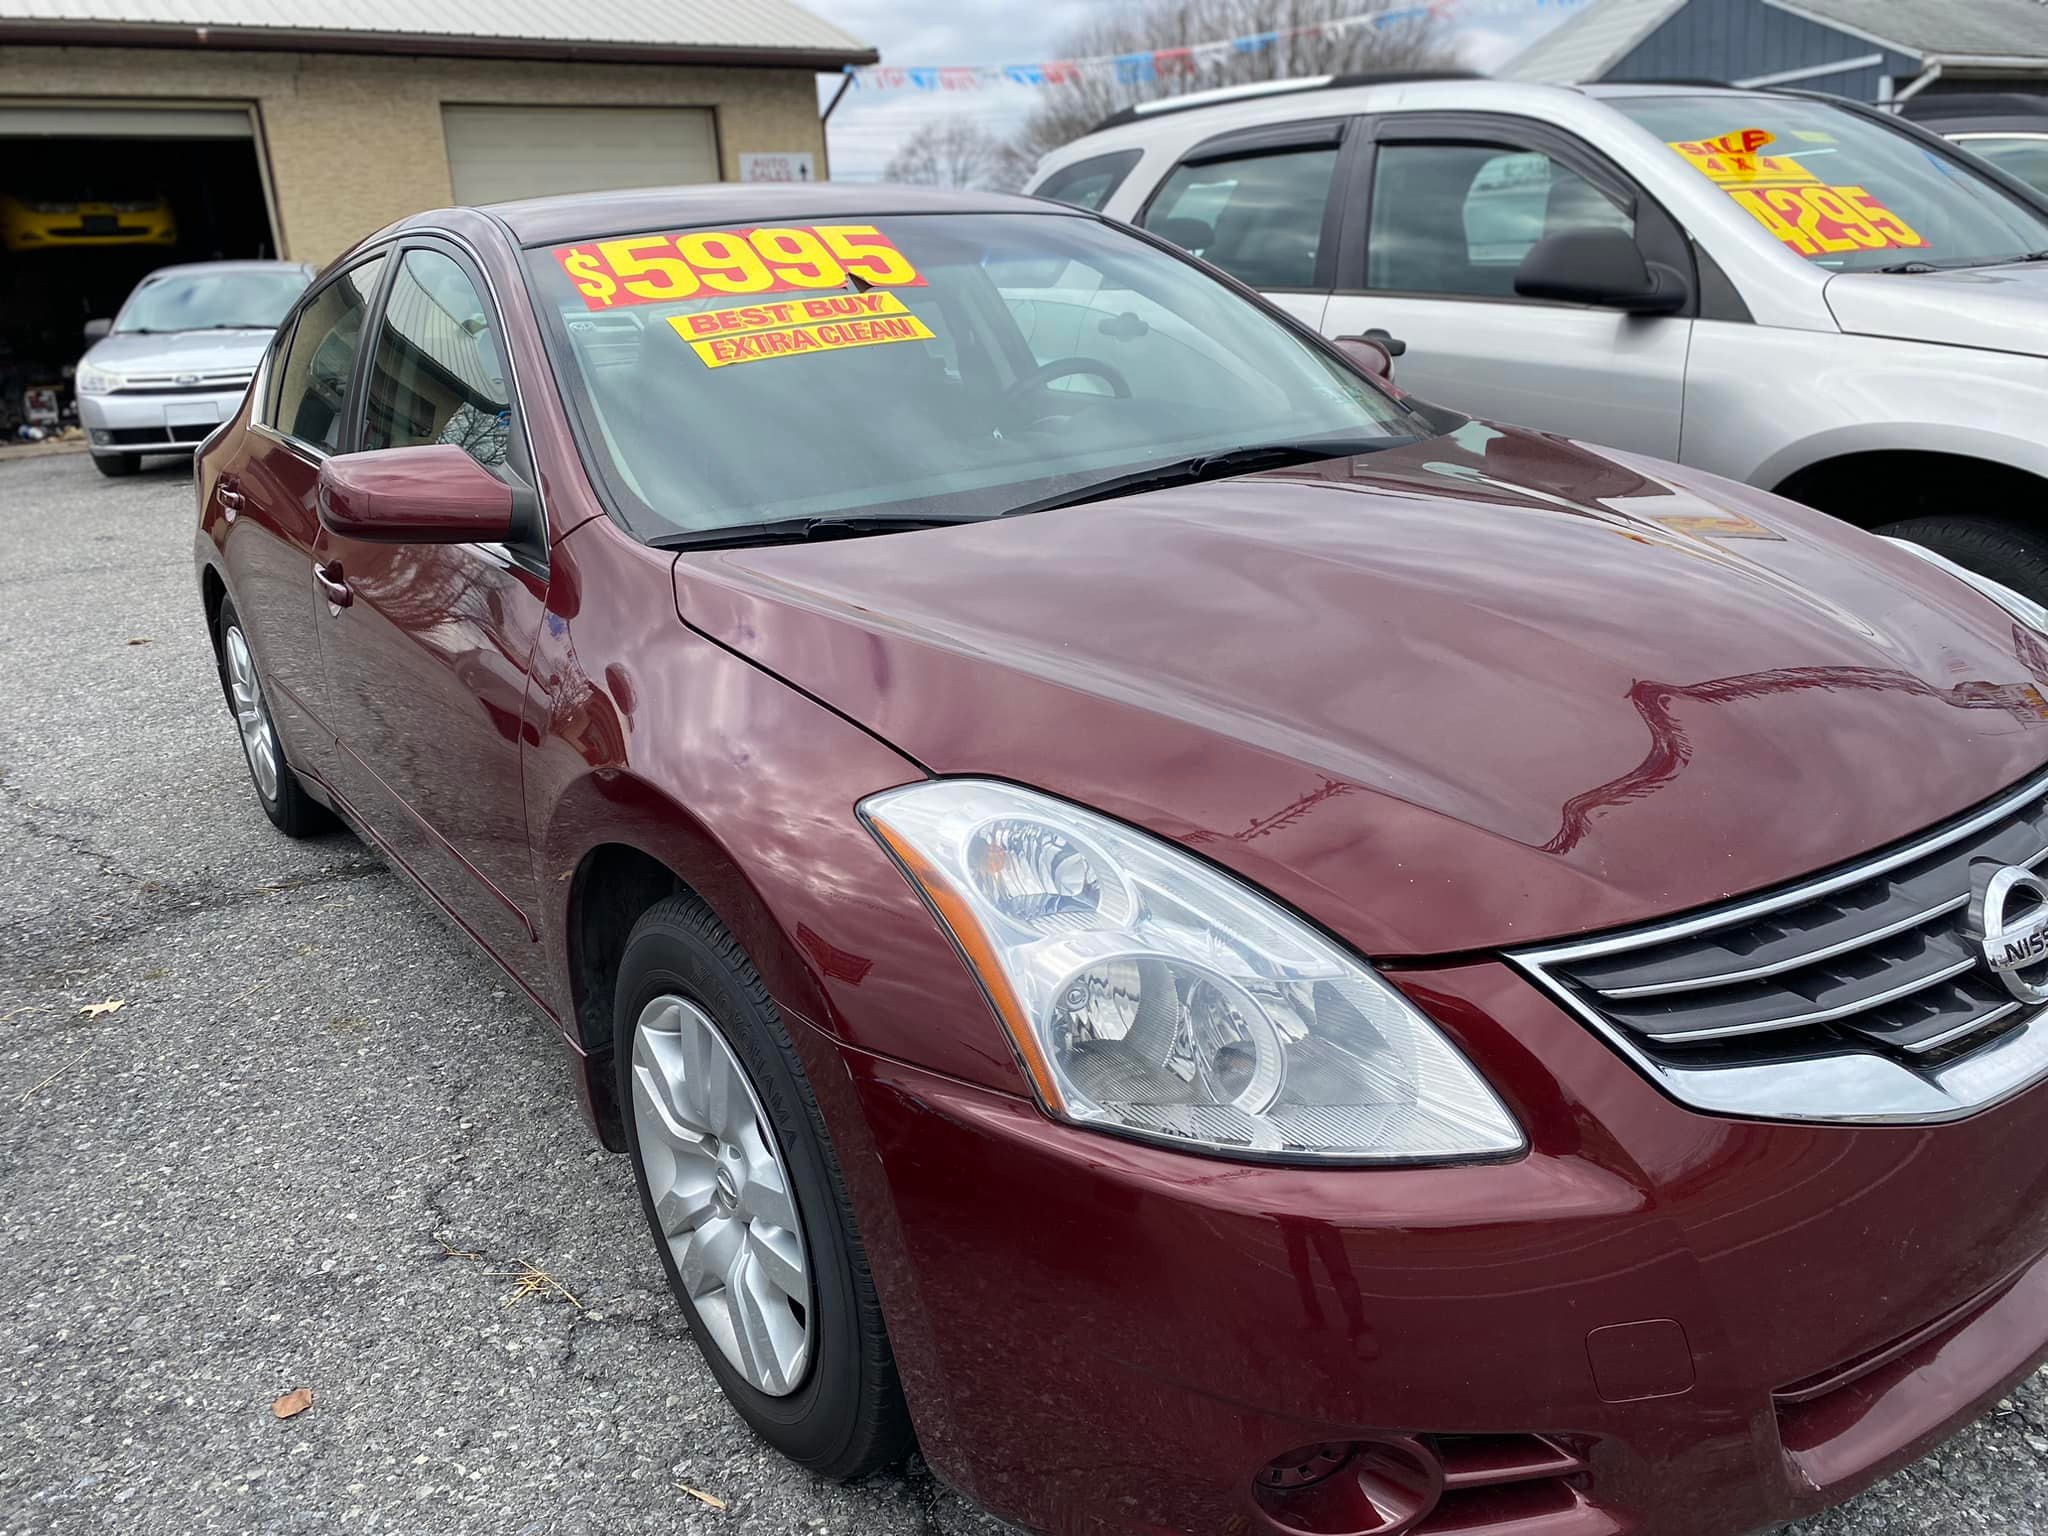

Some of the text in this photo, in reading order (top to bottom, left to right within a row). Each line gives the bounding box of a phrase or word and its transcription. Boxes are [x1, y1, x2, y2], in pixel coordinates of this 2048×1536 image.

[1728, 186, 1921, 254] 4295
[565, 225, 916, 305] $5995
[689, 294, 888, 335] BEST BUY
[710, 319, 916, 362] EXTRA CLEAN
